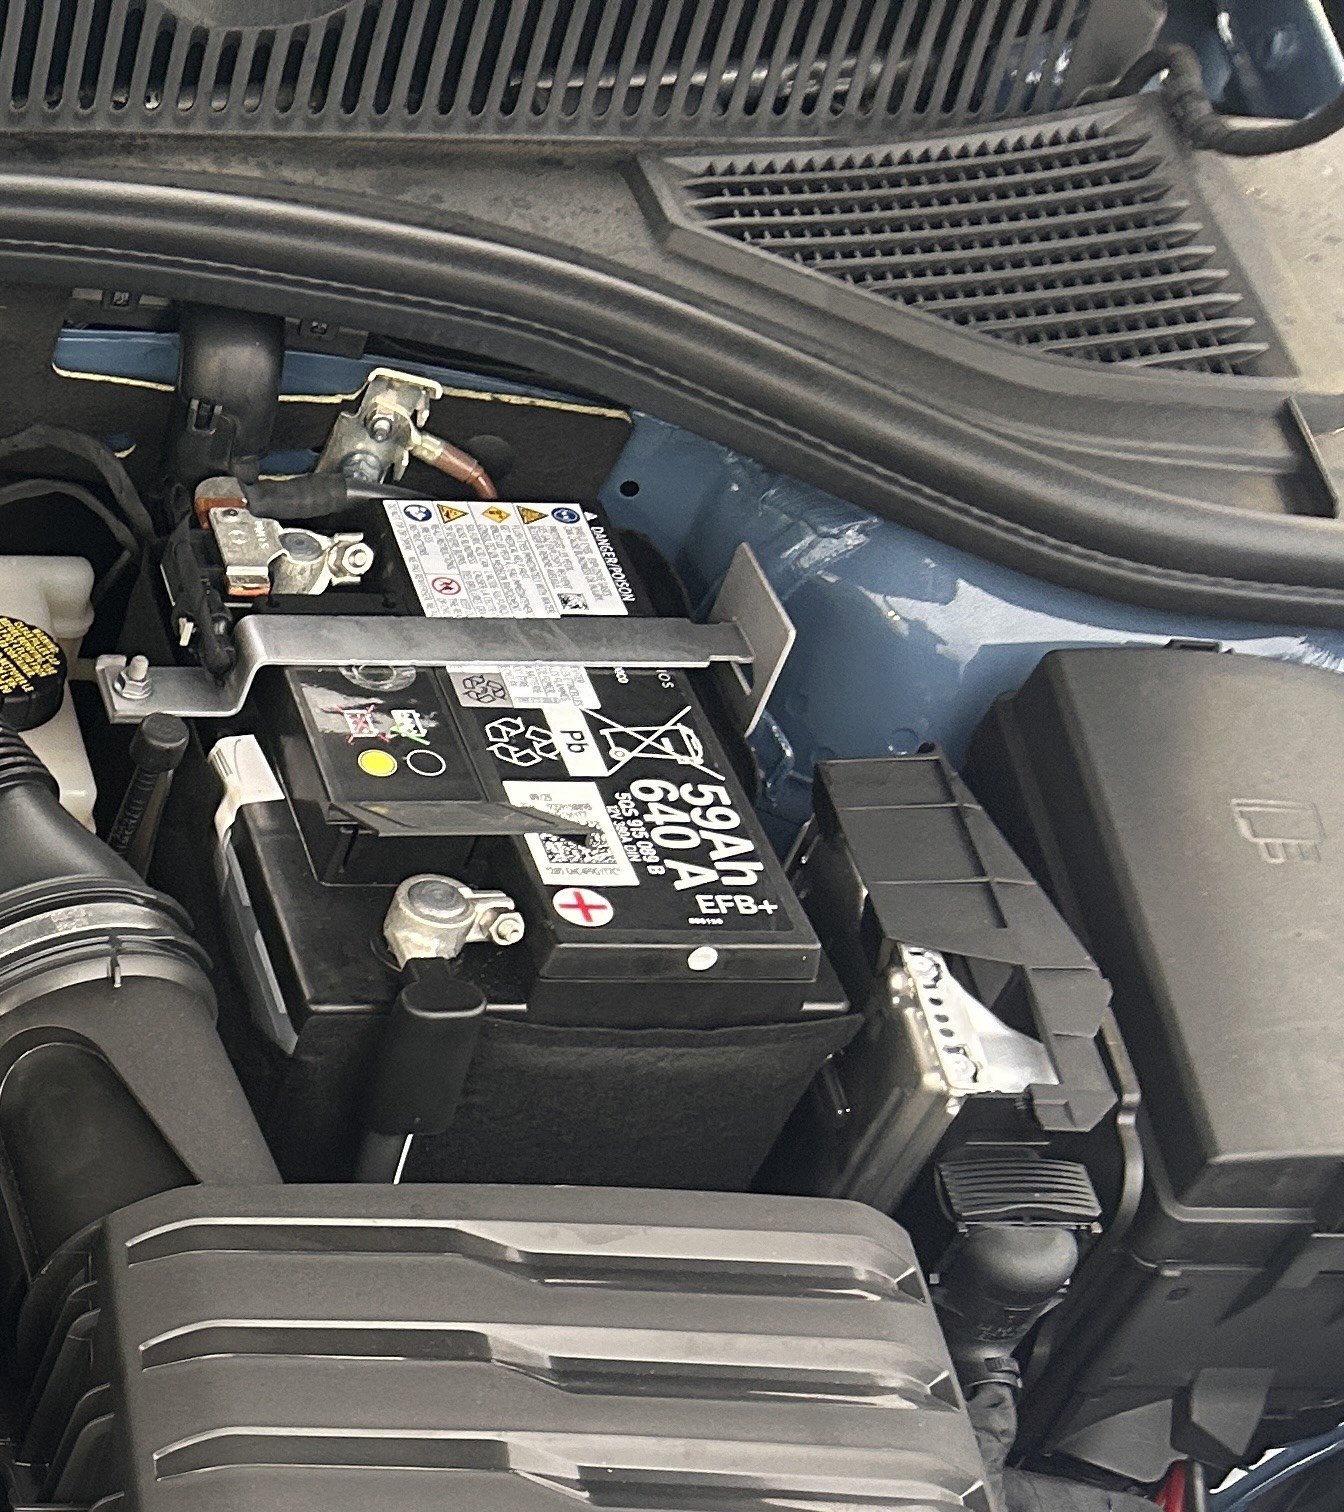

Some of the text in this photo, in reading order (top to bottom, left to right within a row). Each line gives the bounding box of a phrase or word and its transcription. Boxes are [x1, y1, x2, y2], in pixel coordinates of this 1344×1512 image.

[591, 526, 635, 601] DANGER/POISON
[560, 730, 585, 754] Pb
[629, 779, 701, 849] 640
[679, 783, 764, 886] 59Ah
[624, 843, 641, 863] DIN
[630, 818, 649, 842] 915
[647, 864, 666, 876] B
[664, 859, 719, 891] A
[695, 894, 778, 914] EFB+
